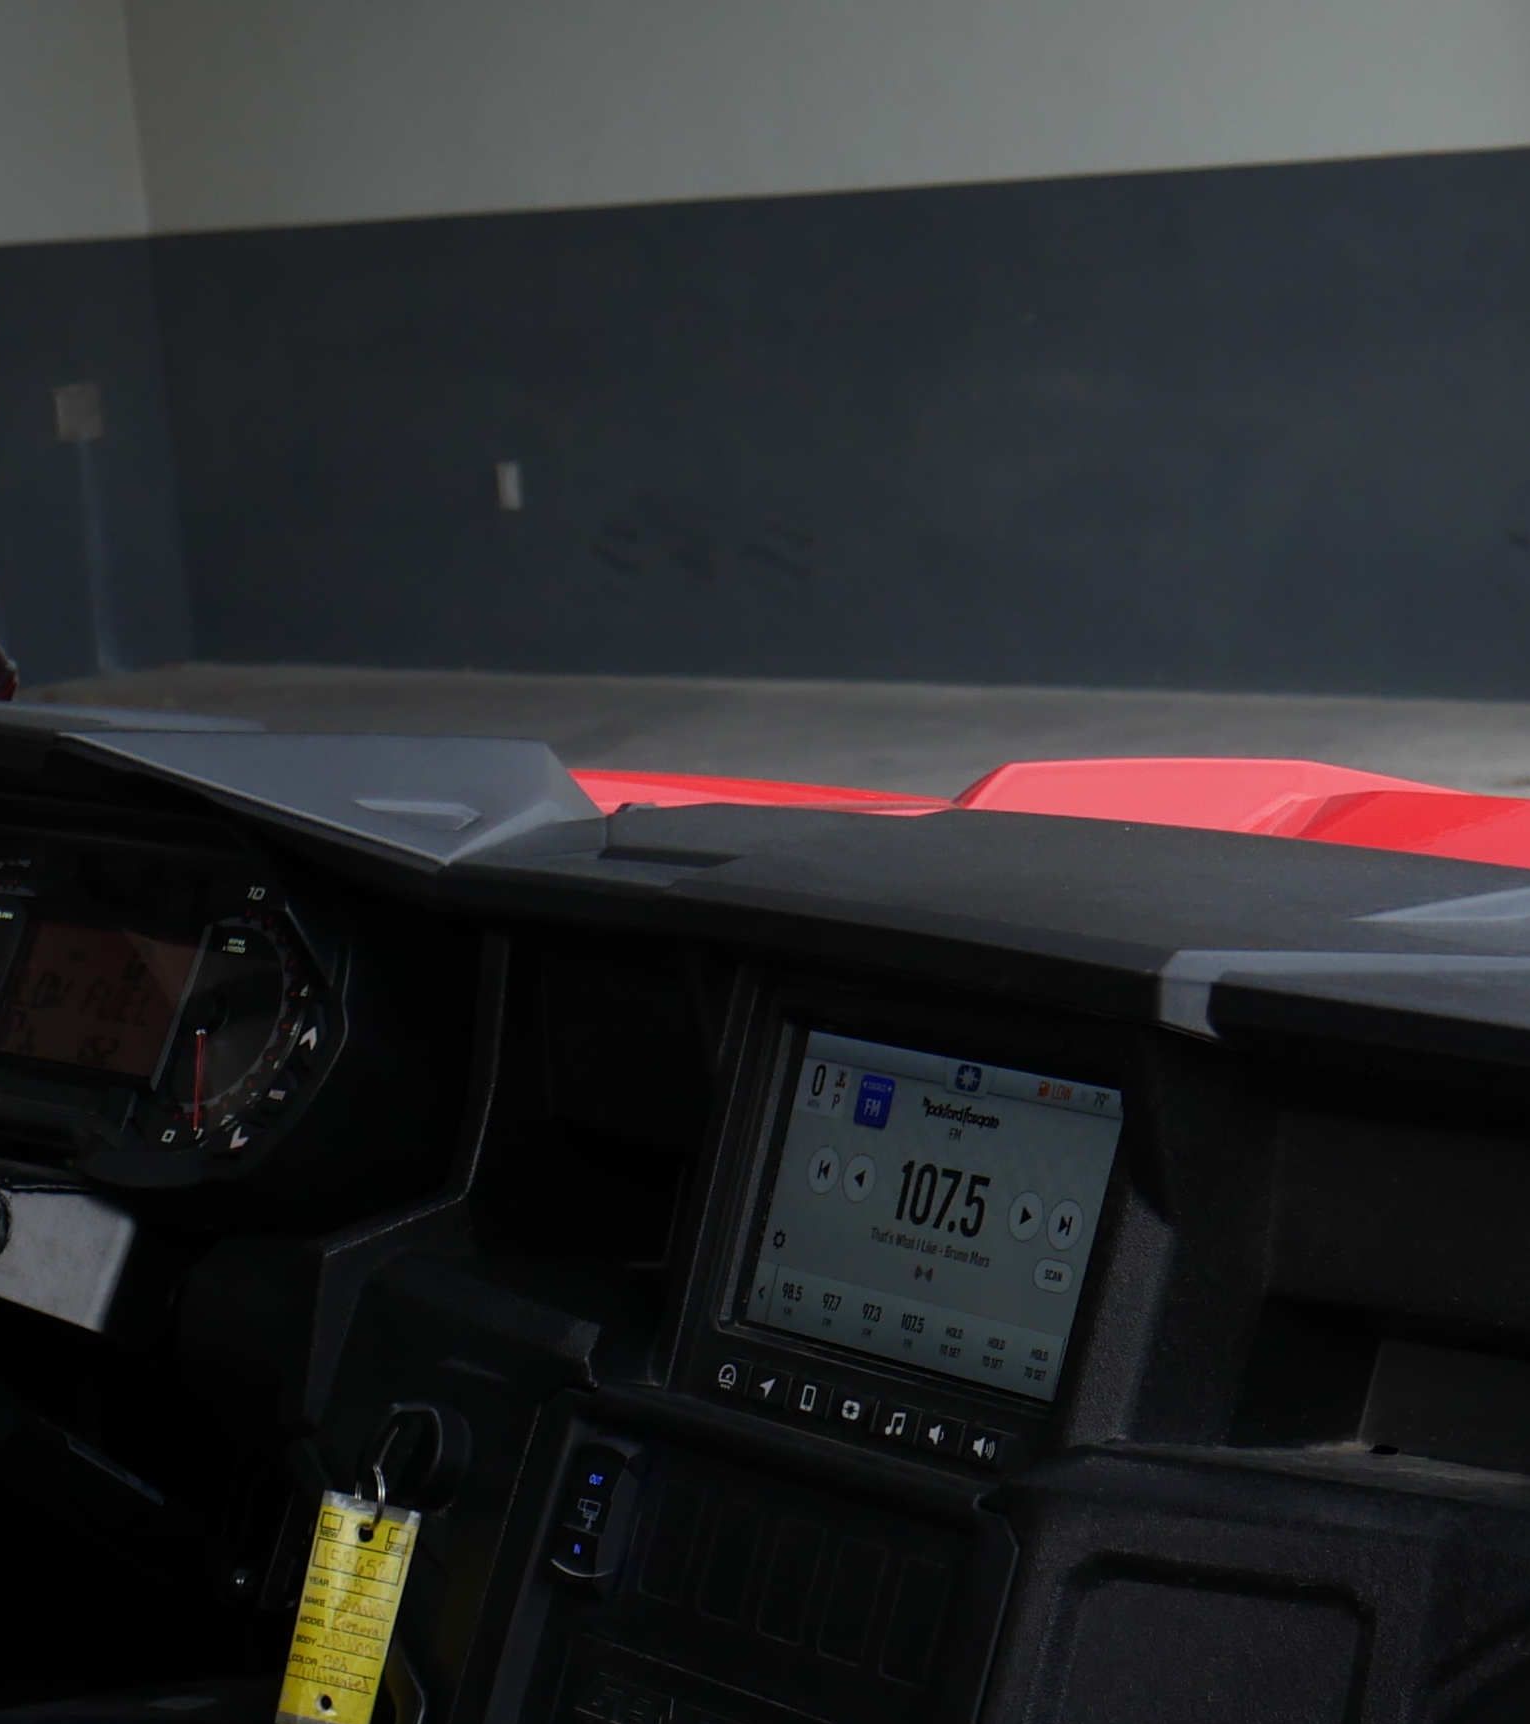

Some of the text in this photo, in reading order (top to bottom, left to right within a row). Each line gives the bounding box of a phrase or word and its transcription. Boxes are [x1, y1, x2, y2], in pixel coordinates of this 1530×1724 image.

[246, 885, 267, 902] 10
[811, 1064, 827, 1097] 0
[1051, 1084, 1074, 1103] LOW
[831, 1094, 841, 1110] P
[863, 1098, 882, 1118] FM
[160, 1128, 176, 1144] 0
[948, 1128, 962, 1142] FM
[895, 1160, 991, 1238] 107.5
[870, 1227, 894, 1246] That's
[895, 1232, 916, 1250] What
[920, 1238, 937, 1255] Like
[944, 1244, 969, 1263] Bruno
[969, 1250, 990, 1268] Mars
[1043, 1268, 1064, 1284] SCAN
[782, 1282, 803, 1303] 98.5
[822, 1292, 842, 1312] 97.7
[862, 1302, 882, 1323] 97.3
[900, 1312, 926, 1335] 107.5
[945, 1325, 964, 1341] HOLD
[987, 1336, 1006, 1351] HOLD
[948, 1345, 961, 1359] SET
[1030, 1347, 1049, 1362] HOLD
[990, 1356, 1004, 1370] SET
[1033, 1367, 1047, 1382] SET
[320, 1528, 340, 1539] NEW
[309, 1576, 330, 1588] YEAR
[304, 1595, 326, 1608] MAKE
[299, 1614, 326, 1628] MODEL
[295, 1633, 318, 1646] BODY
[291, 1653, 318, 1667] COLOR
